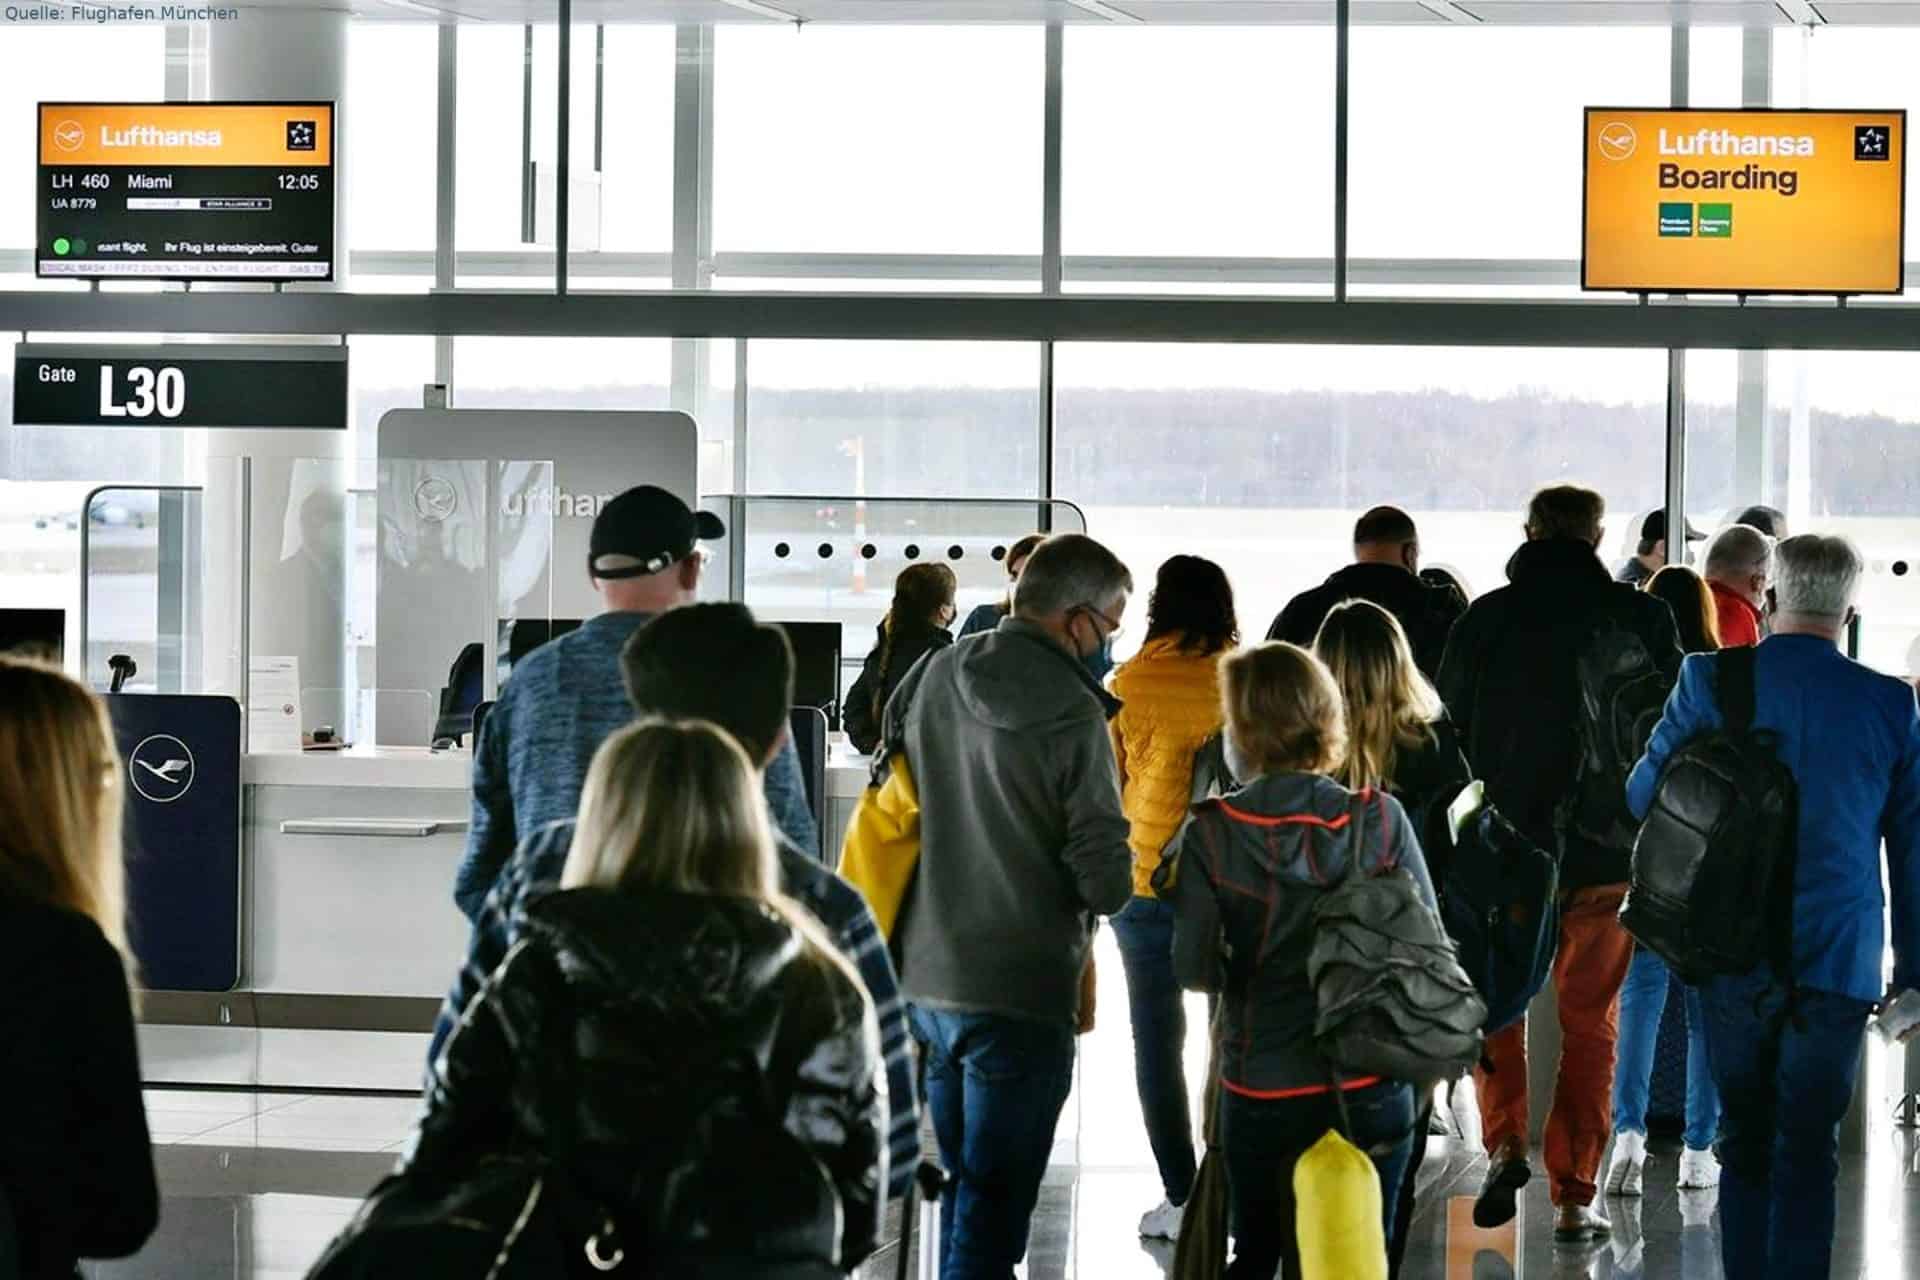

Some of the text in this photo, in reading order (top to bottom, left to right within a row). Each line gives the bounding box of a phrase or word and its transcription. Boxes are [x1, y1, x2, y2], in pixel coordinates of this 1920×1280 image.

[101, 126, 222, 147] Lufthansa
[1659, 128, 1815, 156] Lufthansa
[52, 174, 319, 190] LH 460 Miami 12:05
[1659, 163, 1798, 196] Boarding
[52, 198, 97, 209] UA 8779
[38, 364, 186, 419] Gate L30
